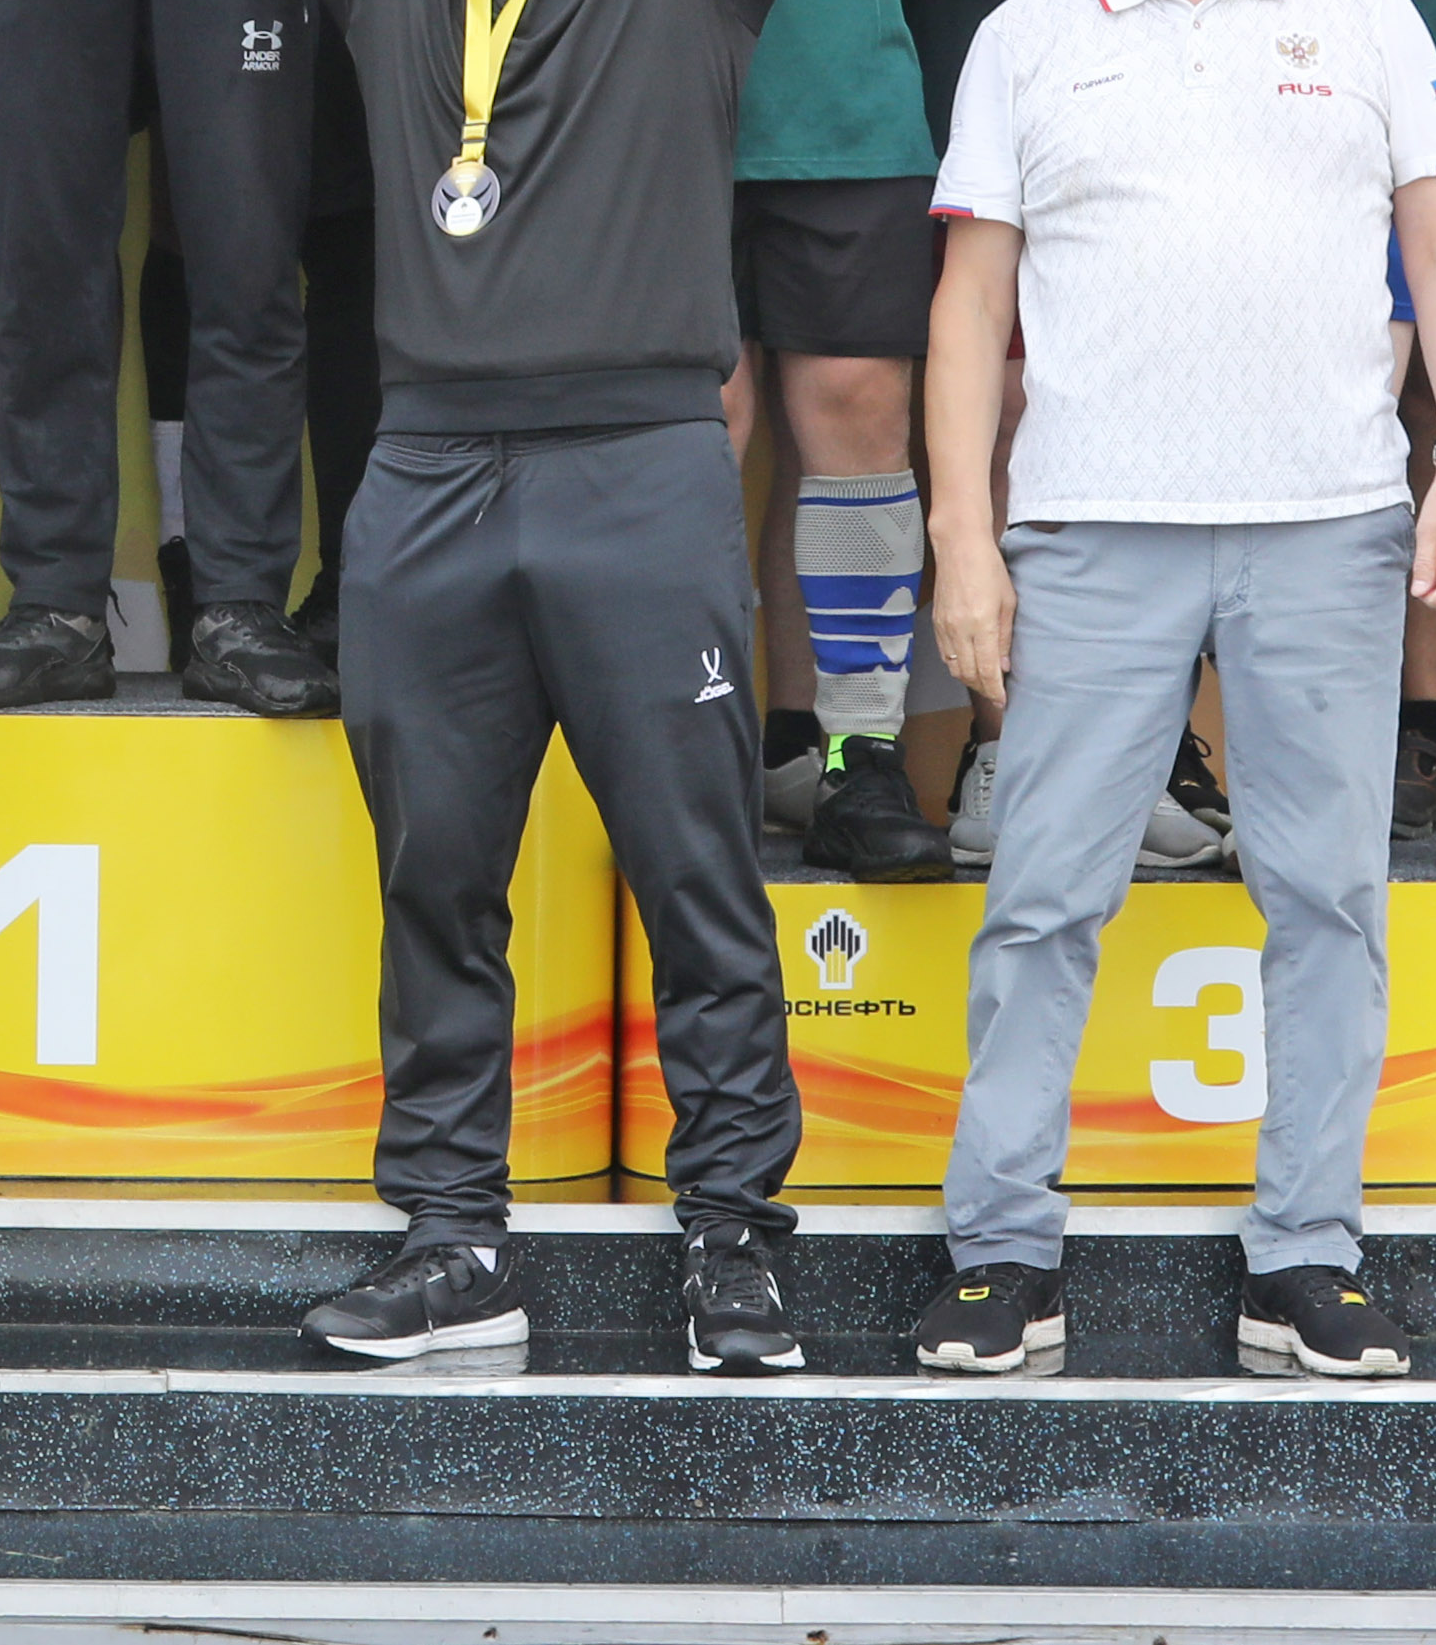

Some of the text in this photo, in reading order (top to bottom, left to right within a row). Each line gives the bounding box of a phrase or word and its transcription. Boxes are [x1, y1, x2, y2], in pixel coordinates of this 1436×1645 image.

[243, 50, 281, 62] UNDER
[241, 60, 280, 71] ARMOUR
[1277, 82, 1333, 97] RUS
[1150, 946, 1268, 1122] 3
